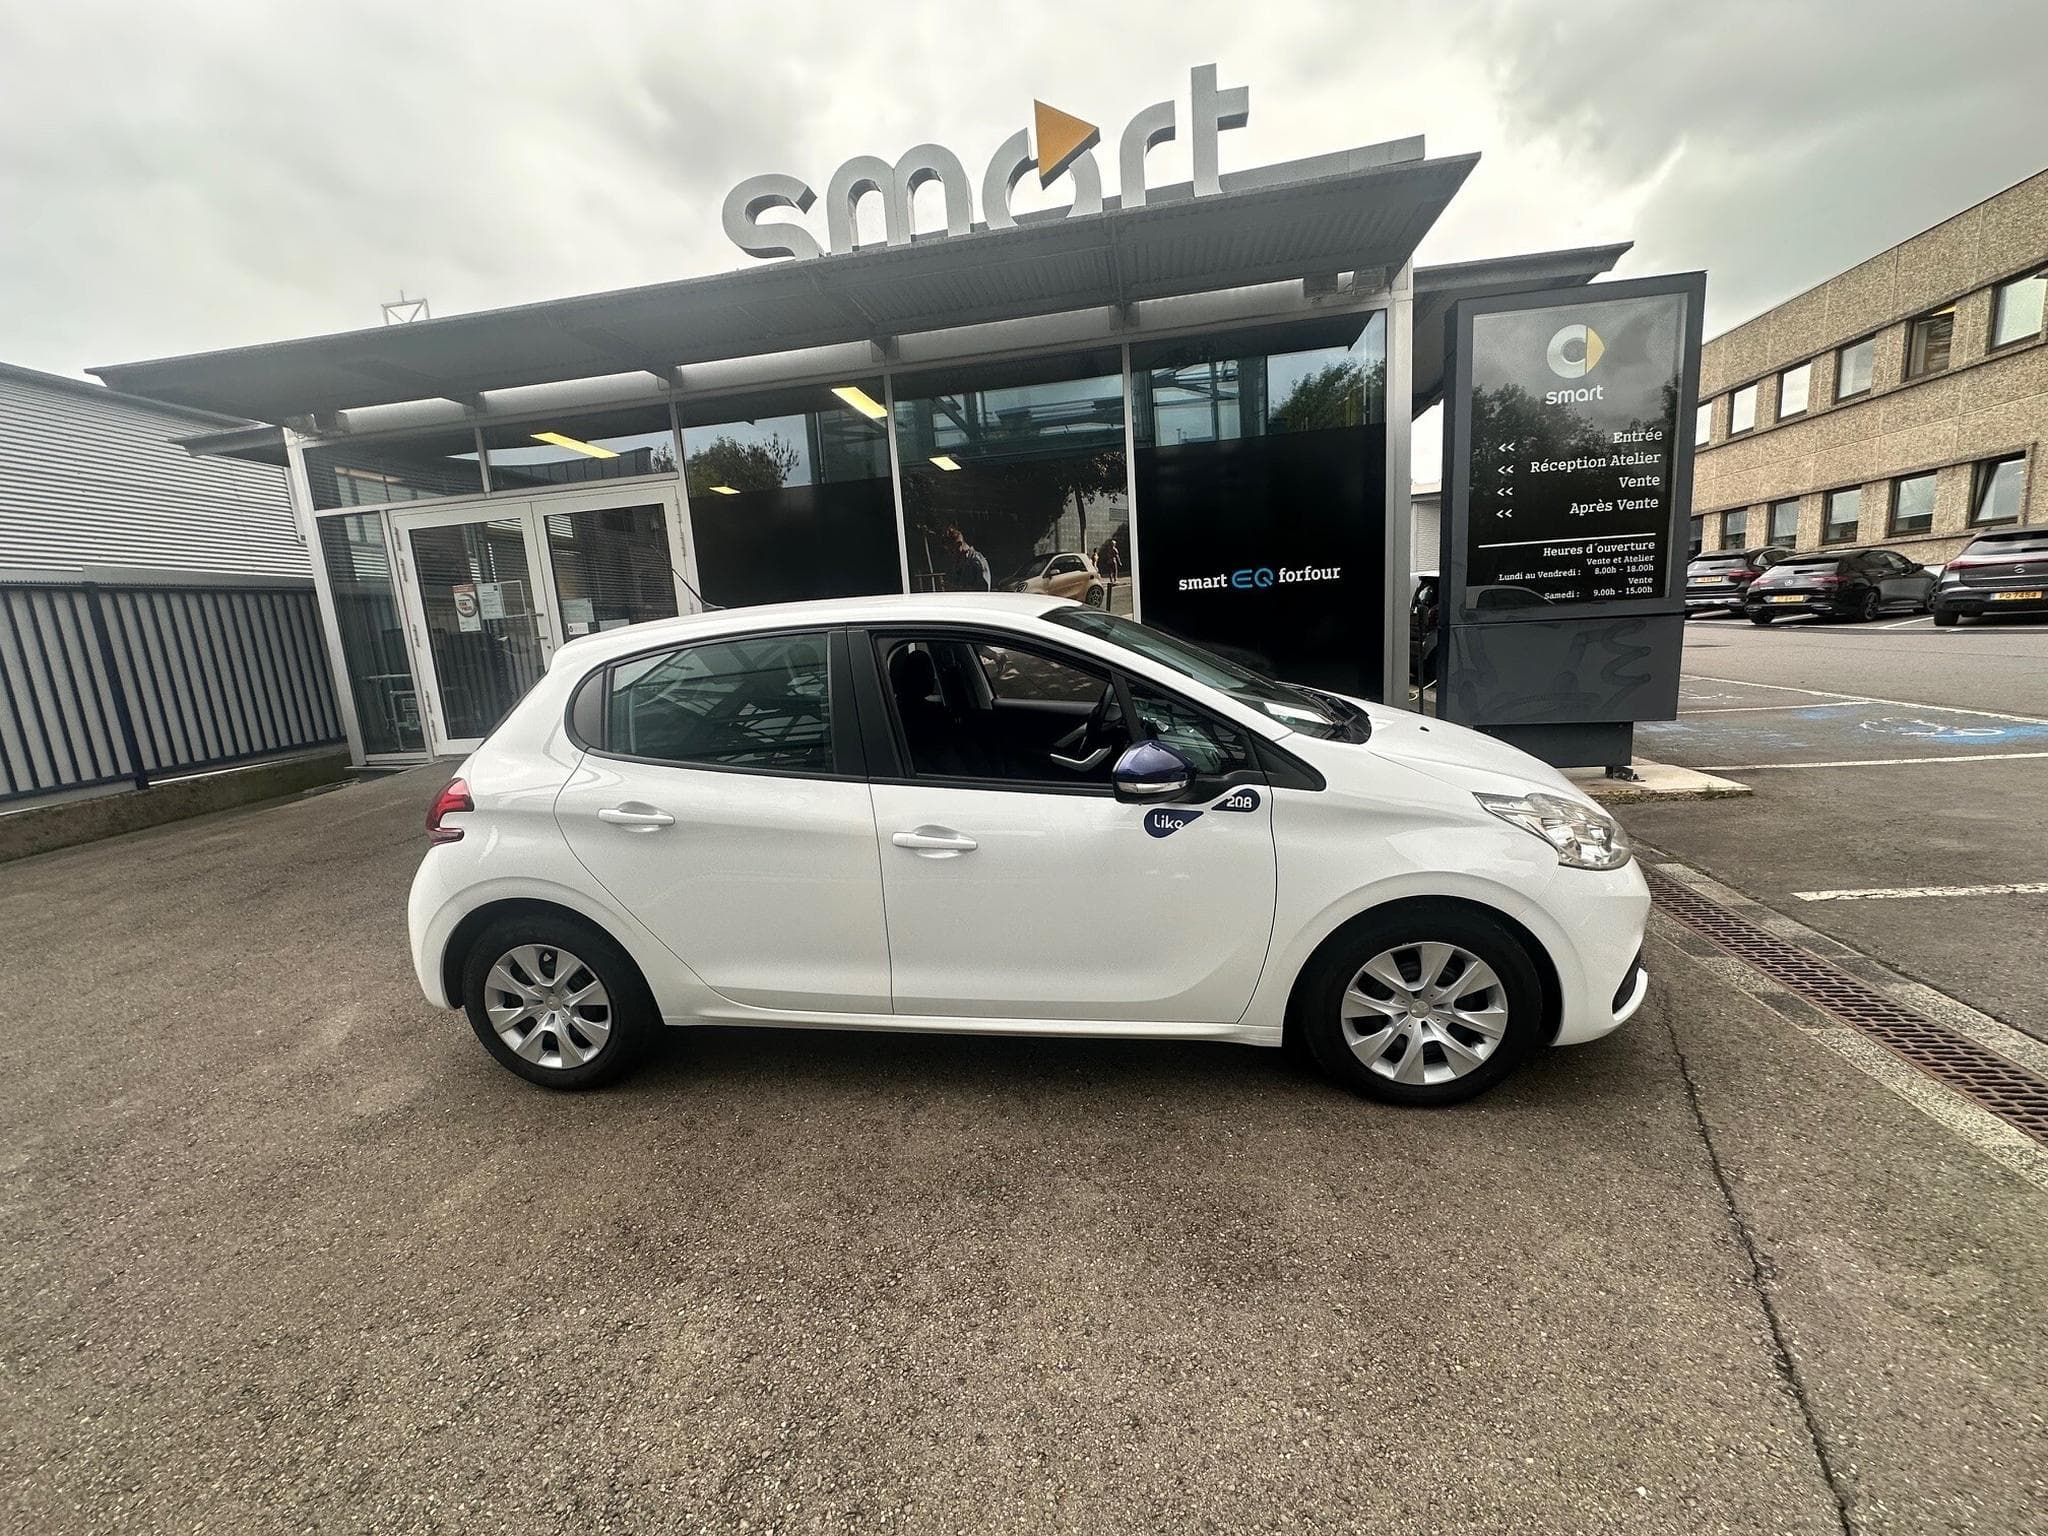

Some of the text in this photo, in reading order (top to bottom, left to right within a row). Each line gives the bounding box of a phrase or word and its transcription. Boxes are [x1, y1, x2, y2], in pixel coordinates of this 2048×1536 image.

[722, 62, 1249, 262] smart
[1545, 385, 1604, 405] smart
[1613, 427, 1663, 444] Entrée
[1530, 451, 1661, 473] Réception Atelier
[1619, 475, 1660, 488] Vente
[1569, 497, 1659, 516] Après Vente
[1543, 546, 1583, 557] Heures
[1586, 554, 1655, 566] Vente et Atelier
[1178, 565, 1341, 591] smart EQ forfour
[1499, 572, 1523, 581] Lundi
[1594, 566, 1617, 575] 8.00h
[1626, 564, 1654, 573] 18.00h
[1628, 576, 1653, 585] Vente
[1544, 590, 1575, 600] Samedi
[1593, 588, 1616, 597] 9.00h
[1626, 586, 1653, 595] 15.00h
[1226, 796, 1252, 809] 208
